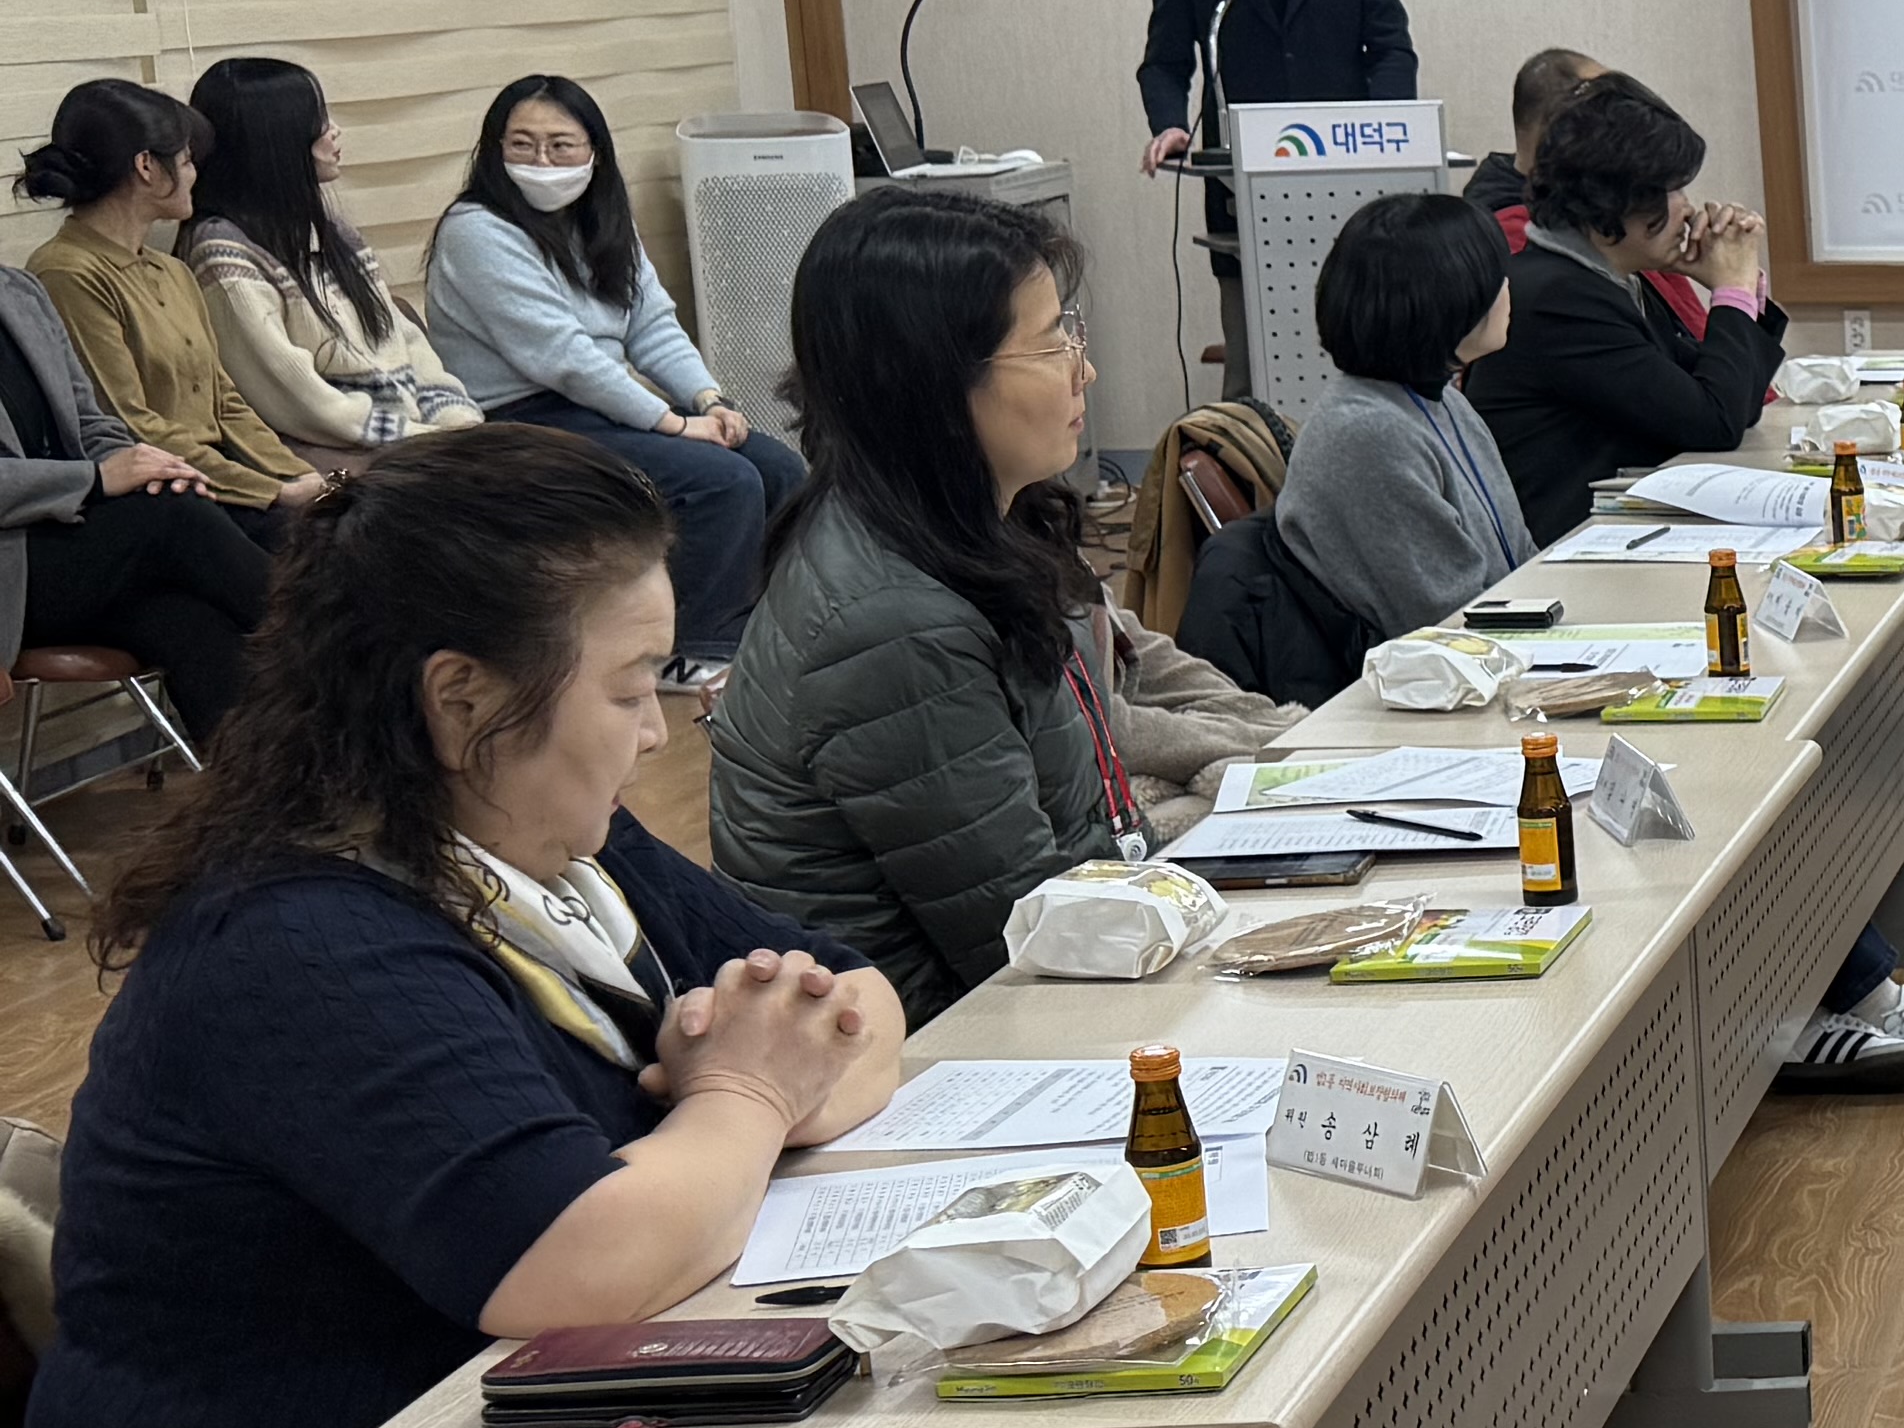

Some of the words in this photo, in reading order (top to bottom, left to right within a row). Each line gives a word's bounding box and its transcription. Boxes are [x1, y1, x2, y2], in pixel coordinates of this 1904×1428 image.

[1331, 121, 1410, 154] 대덕구
[1320, 1111, 1337, 1141] 송
[1361, 1120, 1381, 1151] 삼
